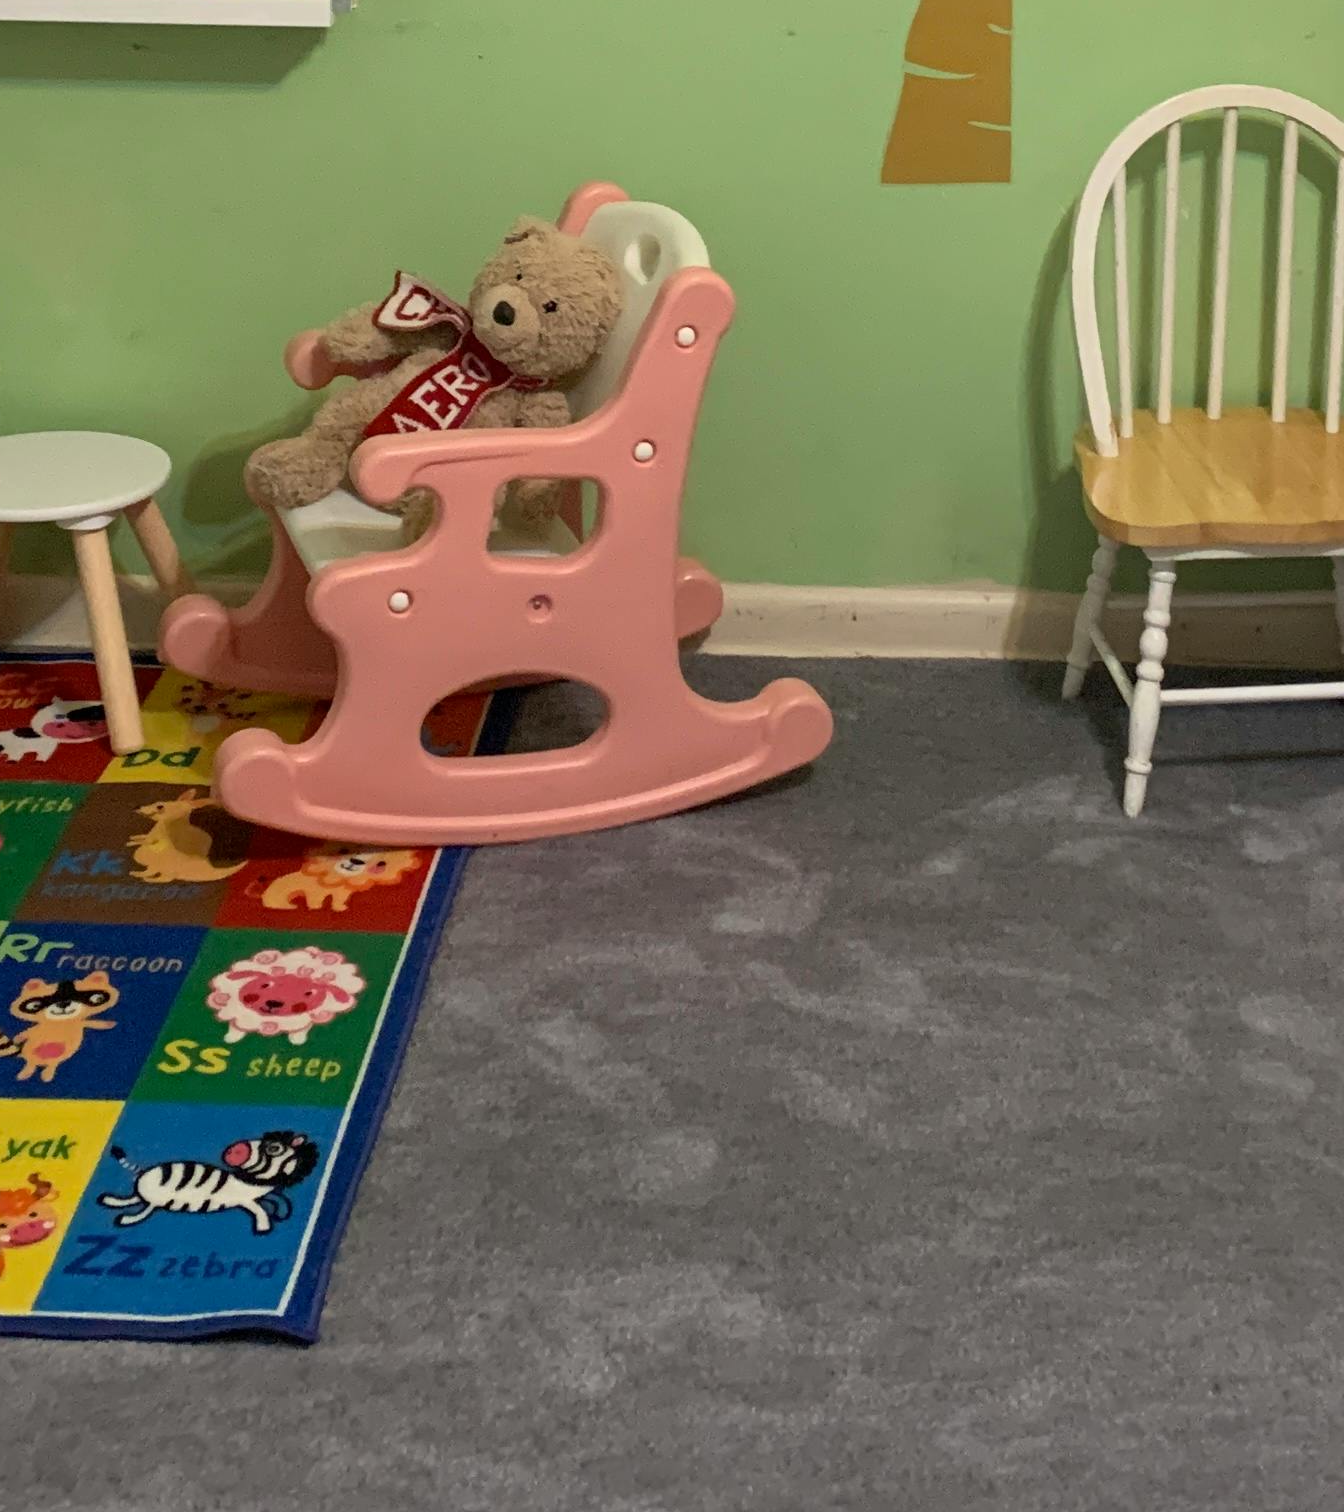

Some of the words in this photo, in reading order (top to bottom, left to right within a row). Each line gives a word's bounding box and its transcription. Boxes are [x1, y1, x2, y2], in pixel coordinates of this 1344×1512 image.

[120, 745, 203, 770] Dd
[55, 951, 186, 975] raccoon
[155, 1038, 233, 1077] Ss
[245, 1054, 344, 1083] sheep
[0, 1132, 83, 1165] yak
[62, 1235, 157, 1279] Zz
[158, 1247, 284, 1281] zebra
